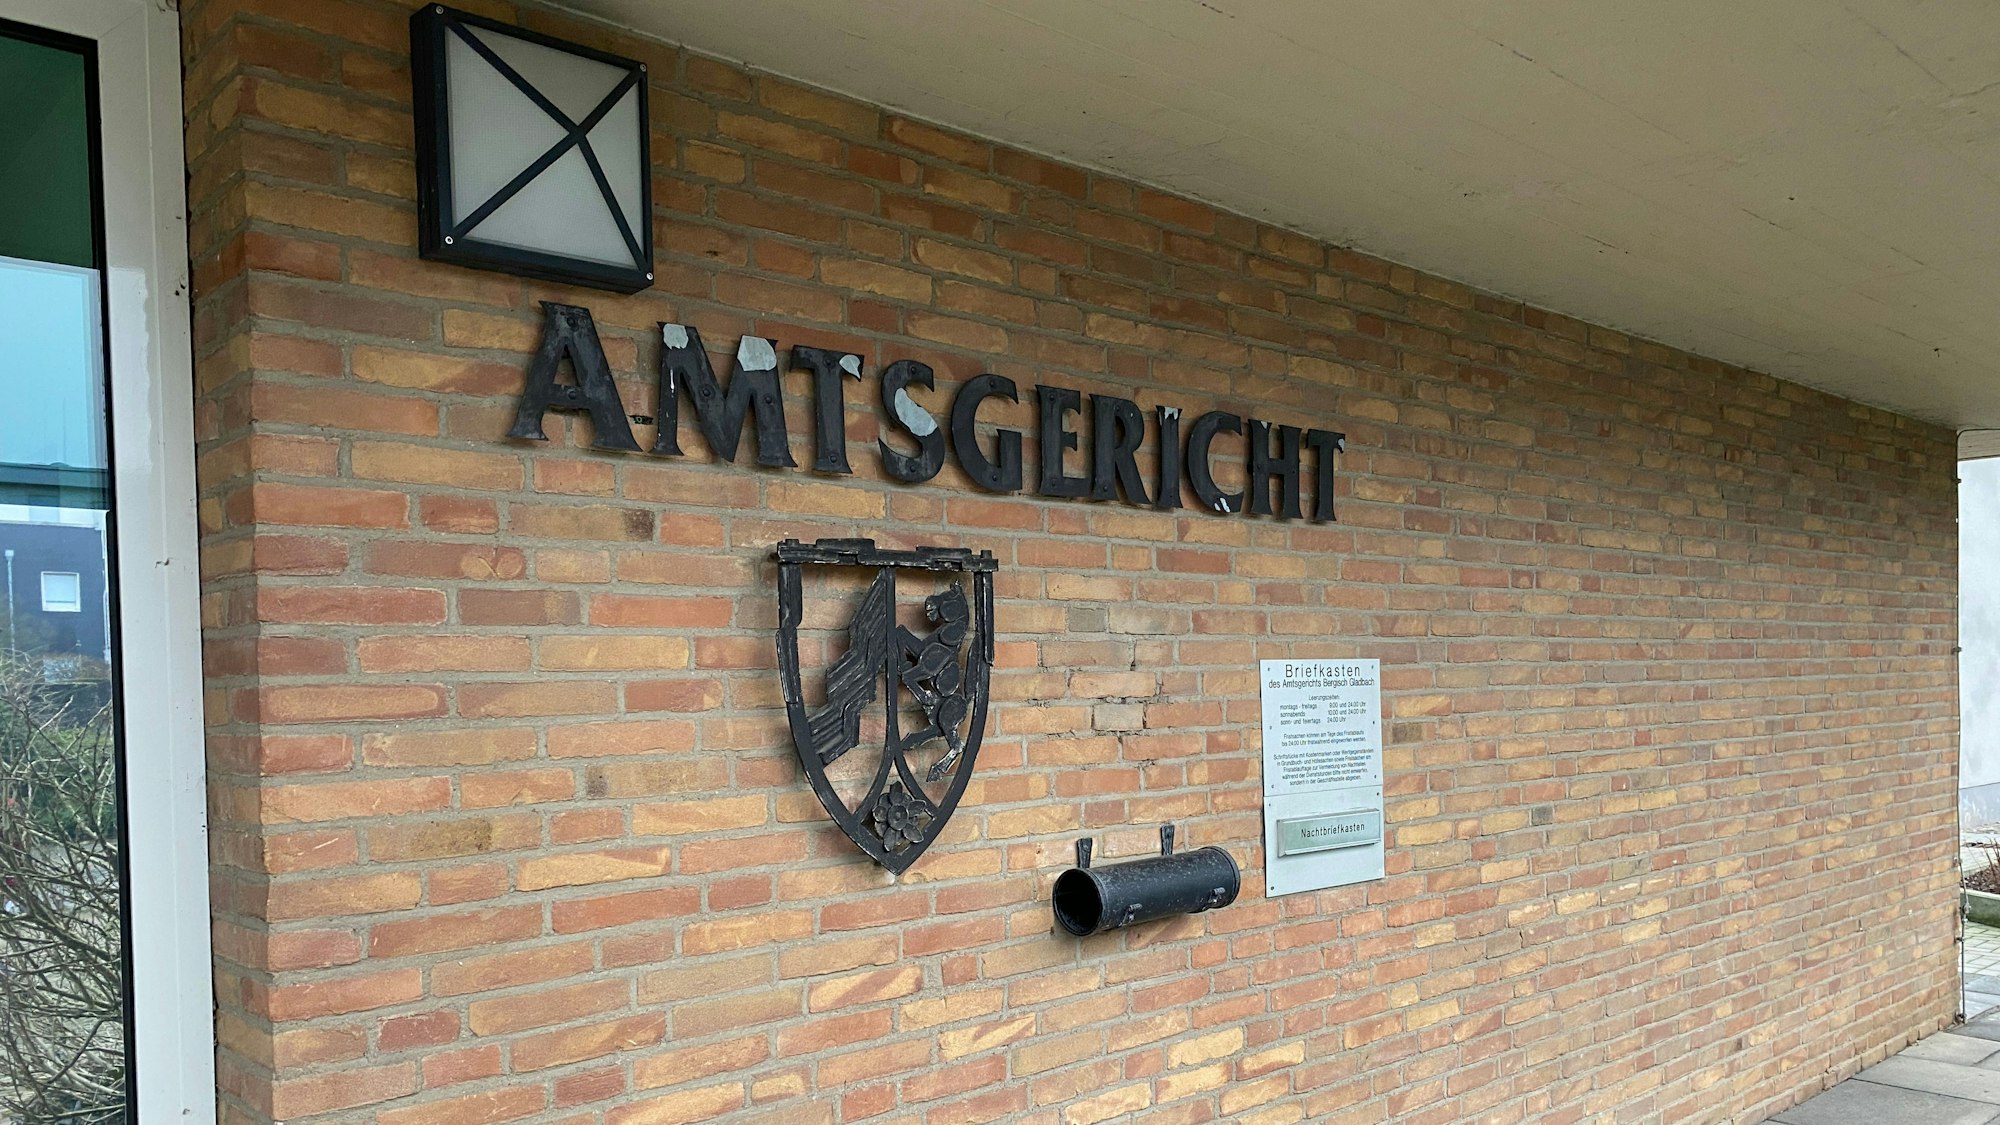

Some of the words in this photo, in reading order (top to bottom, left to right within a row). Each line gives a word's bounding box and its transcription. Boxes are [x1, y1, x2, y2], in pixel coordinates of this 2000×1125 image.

[507, 300, 1346, 522] AMTSGERICHT
[1286, 664, 1360, 677] Briefkasten
[1269, 680, 1280, 688] des
[1283, 679, 1321, 689] Amtsgerichts
[1323, 678, 1347, 689] Bergisch
[1349, 678, 1374, 686] Gladbach
[1301, 823, 1364, 838] Nachtbriefkasten
